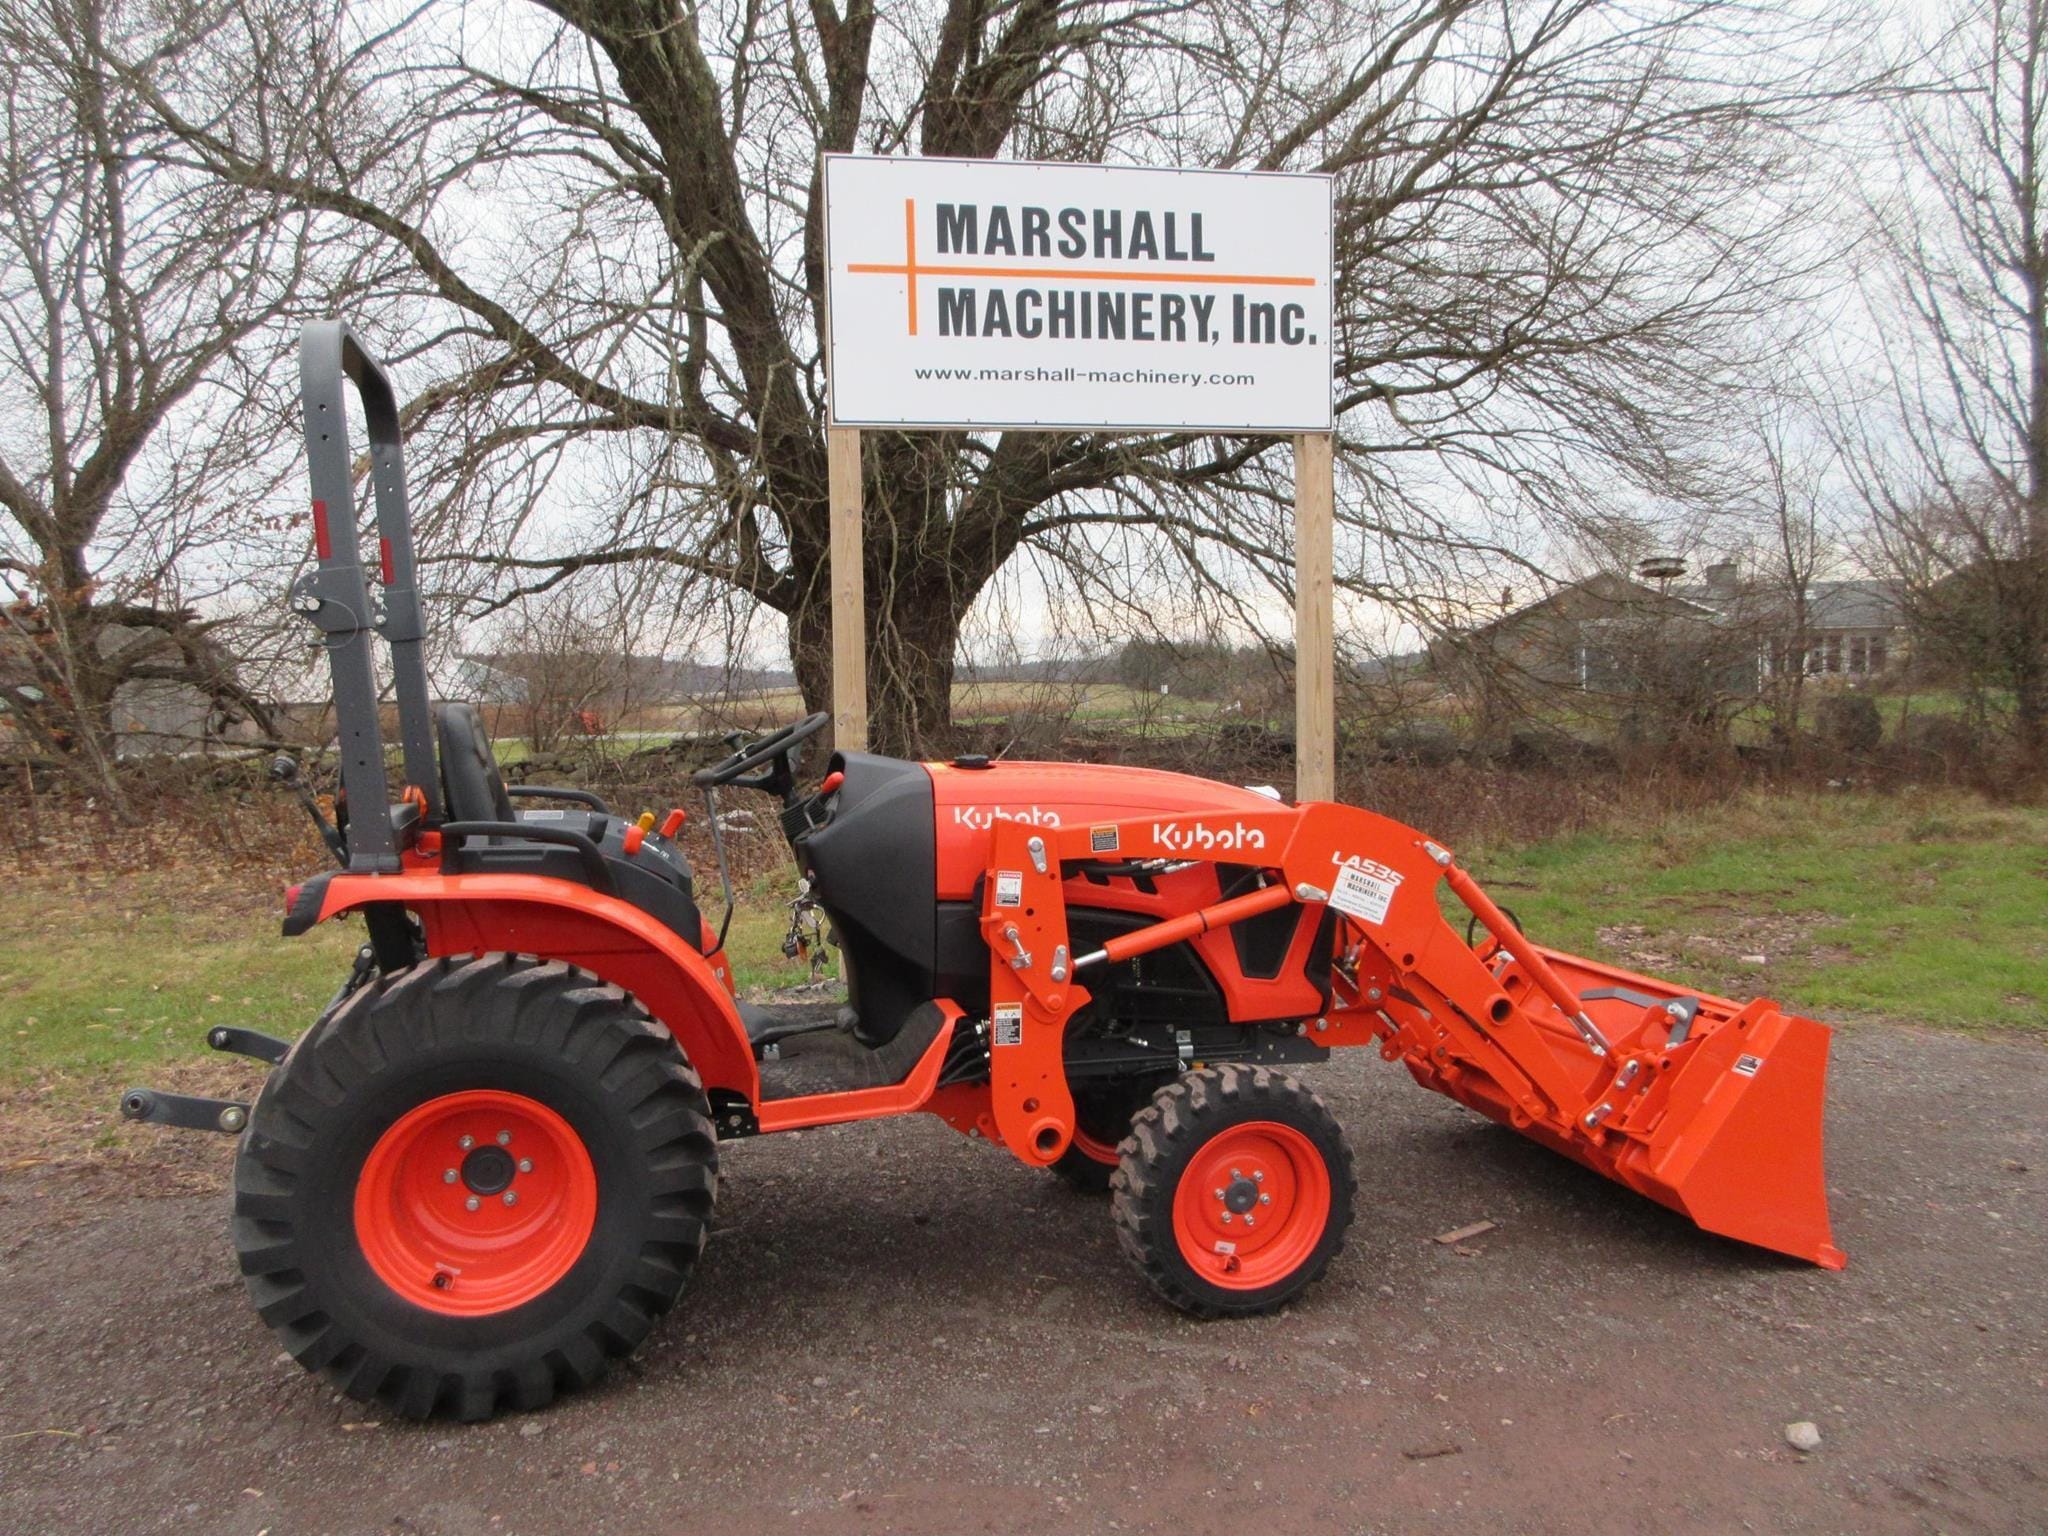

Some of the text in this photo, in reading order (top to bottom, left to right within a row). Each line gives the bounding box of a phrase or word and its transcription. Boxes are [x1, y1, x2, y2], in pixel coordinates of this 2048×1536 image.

[936, 203, 1215, 262] MARSHALL
[938, 287, 1317, 346] MACHINERY, Inc.
[915, 367, 1255, 388] www.marshall-machinery.com
[1153, 822, 1265, 850] Kubota
[1331, 851, 1405, 887] LA535
